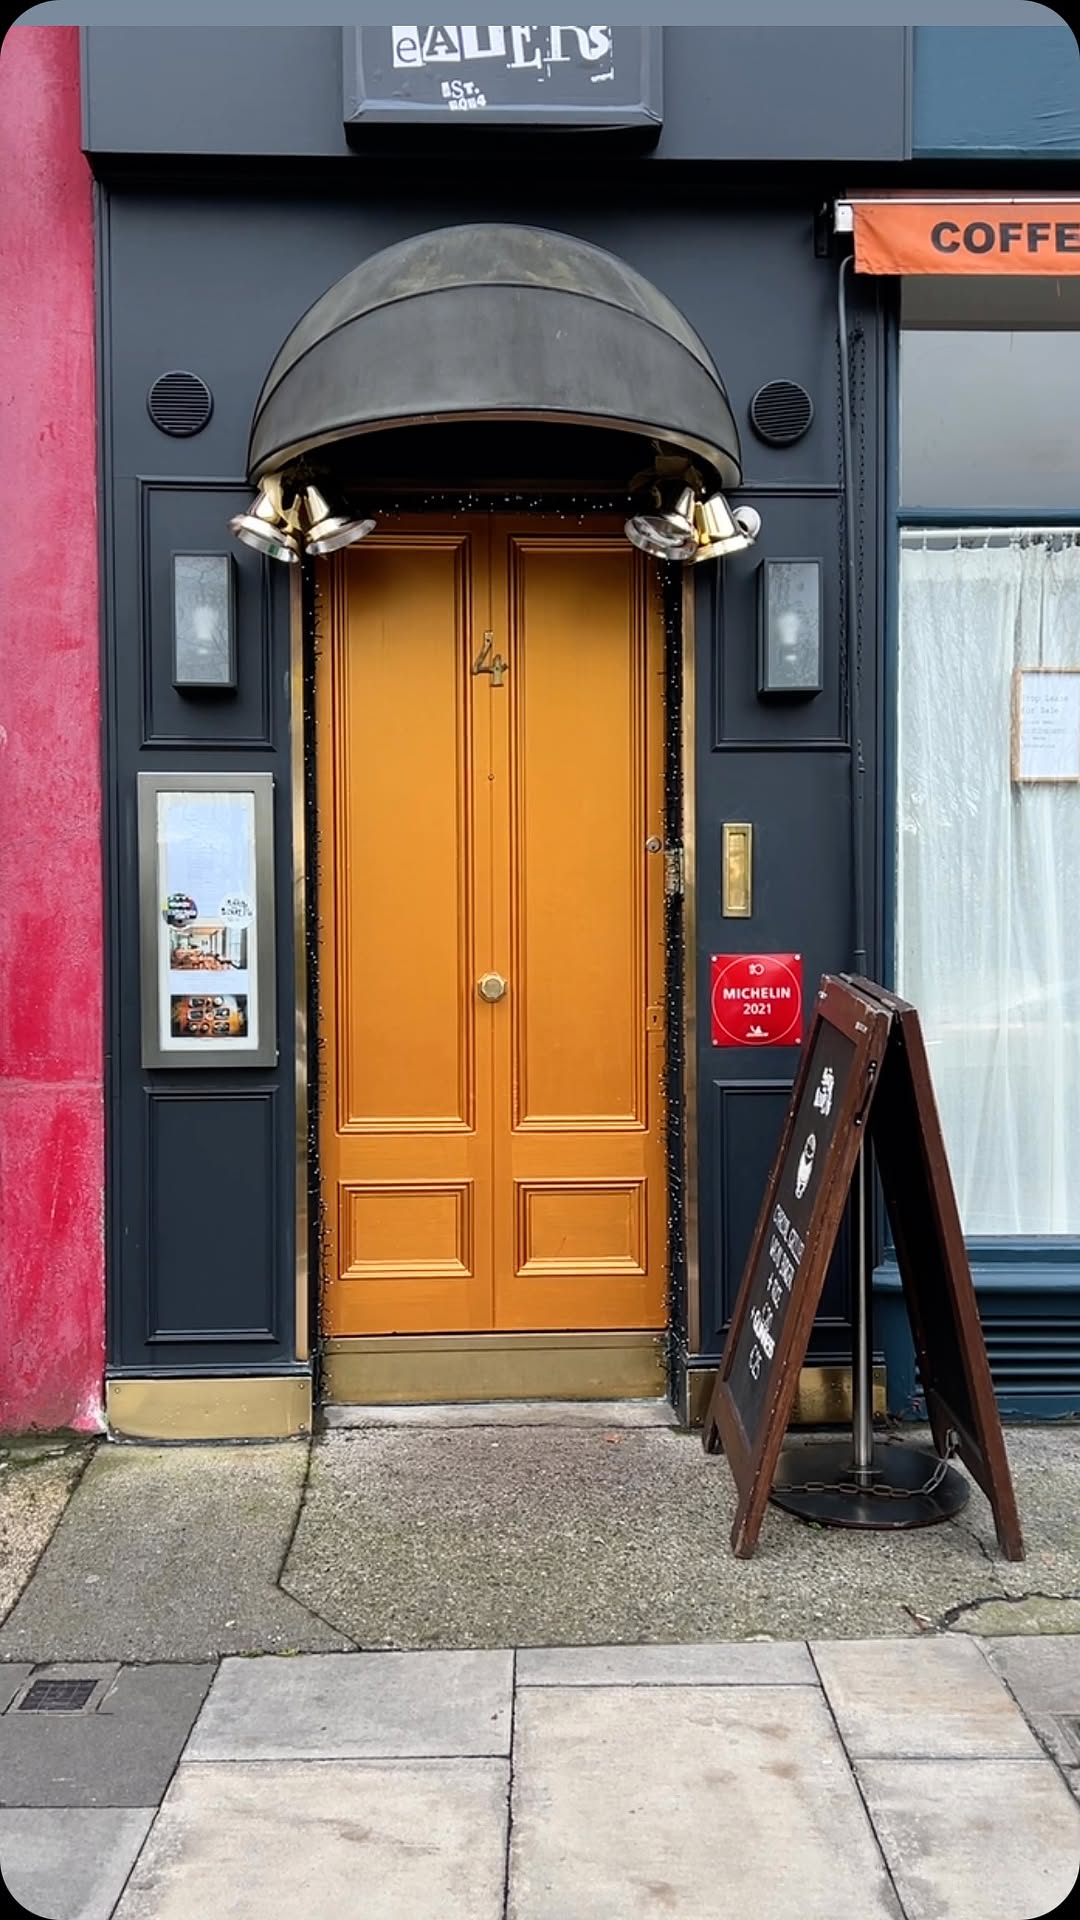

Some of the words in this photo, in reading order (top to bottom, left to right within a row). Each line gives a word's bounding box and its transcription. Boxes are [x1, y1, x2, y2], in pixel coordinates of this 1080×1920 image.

[931, 222, 1080, 253] COFFE
[471, 630, 508, 687] 4
[723, 987, 791, 1000] MICHELIN
[743, 1003, 771, 1015] 2021
